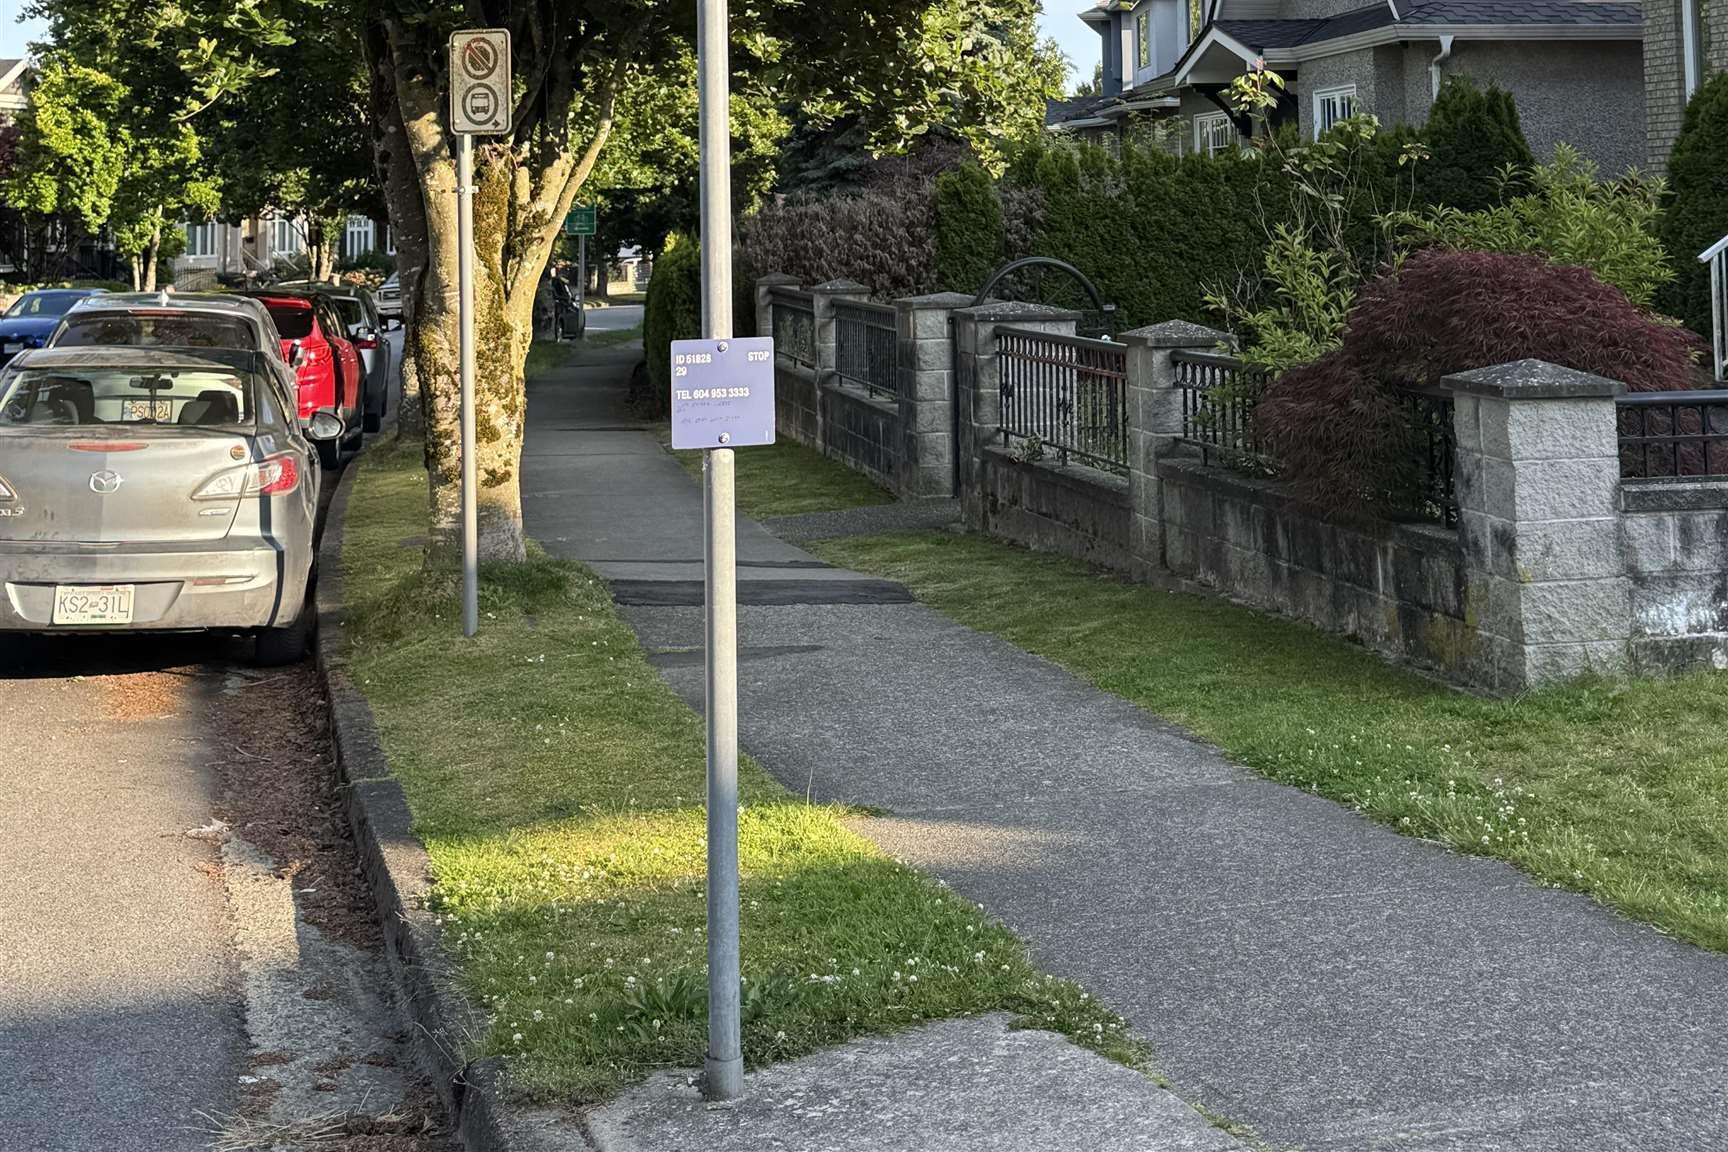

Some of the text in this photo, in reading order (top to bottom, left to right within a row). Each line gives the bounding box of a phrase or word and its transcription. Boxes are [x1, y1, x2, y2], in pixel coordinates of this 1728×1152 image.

[675, 353, 712, 364] ID 51828
[747, 351, 770, 361] STOP
[675, 366, 687, 376] 29
[676, 387, 750, 400] TEL 604 953 3333
